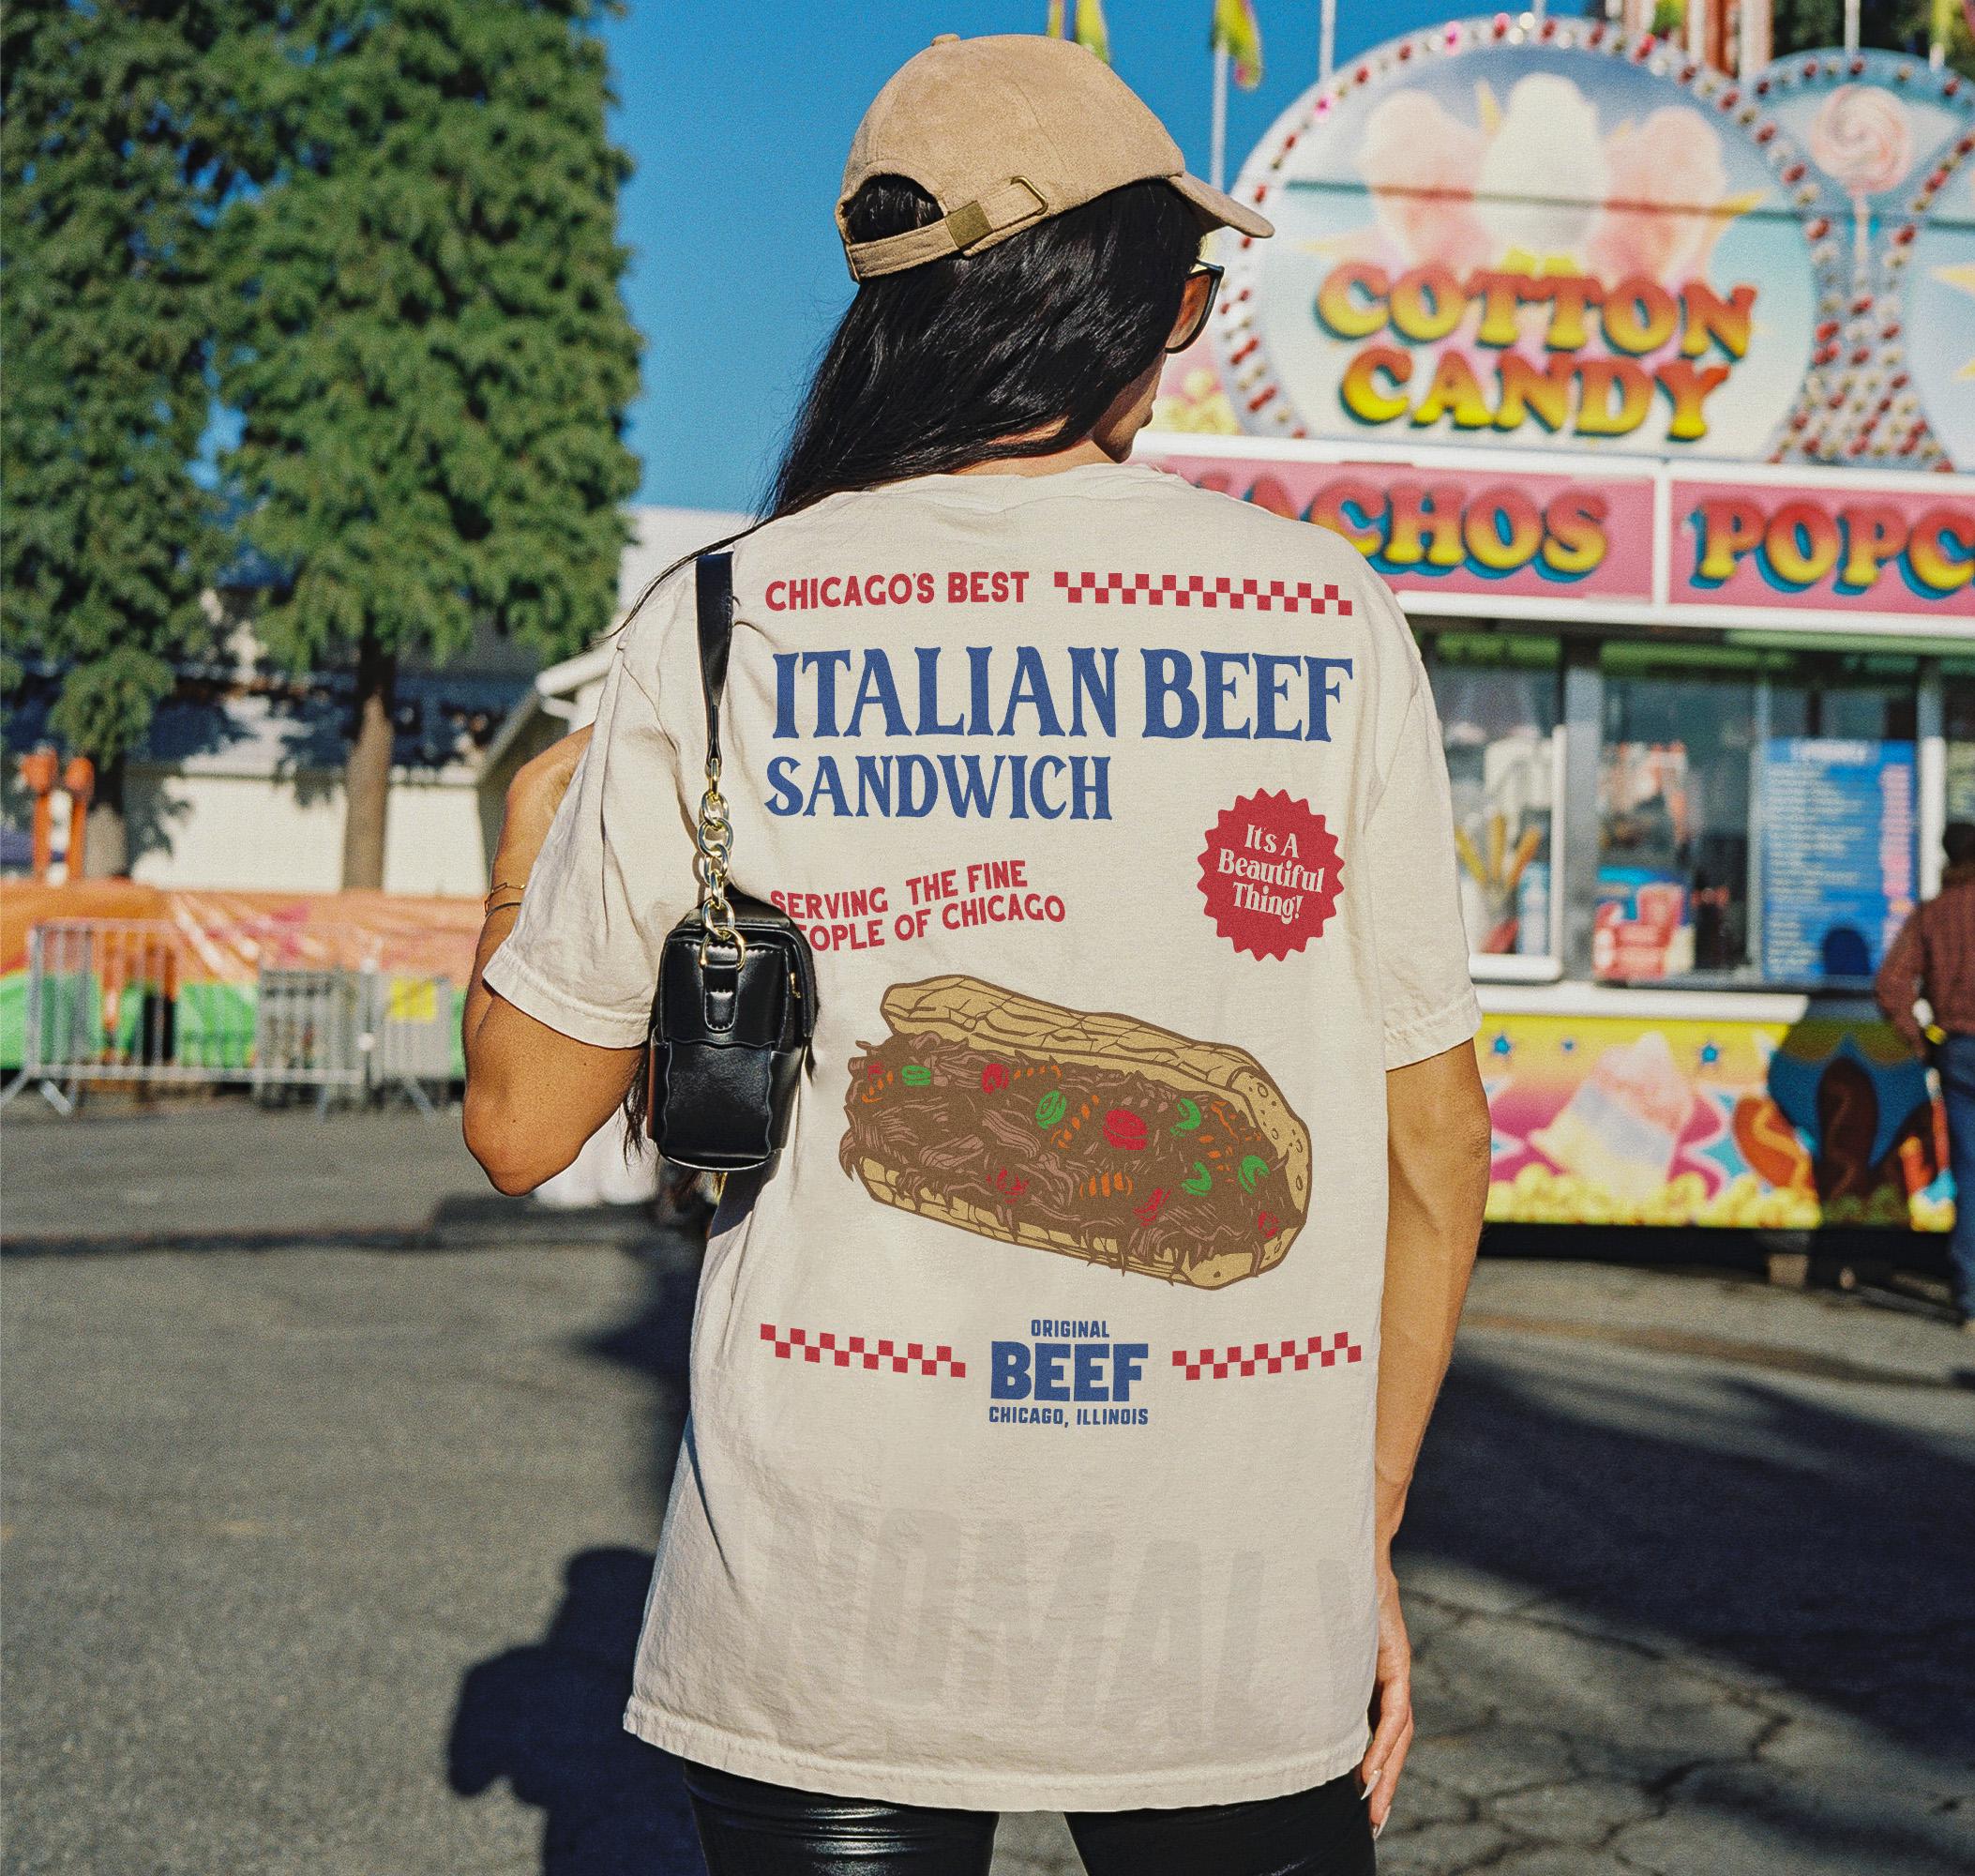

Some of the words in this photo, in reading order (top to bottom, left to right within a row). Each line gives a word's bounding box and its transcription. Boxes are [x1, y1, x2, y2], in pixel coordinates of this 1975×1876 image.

[1315, 261, 1757, 363] COTTON
[1340, 346, 1730, 441] CANDY
[1196, 472, 1609, 582] CHOS
[765, 573, 934, 611] CHICAGO'S
[948, 571, 1030, 603] BEST
[773, 646, 1119, 738] ITALIAN
[1140, 648, 1353, 741] BEEF
[765, 754, 1112, 820] SANDWICH
[1217, 847, 1325, 893] Beautiful
[1280, 833, 1300, 859] A
[770, 887, 888, 919] SERVING
[906, 870, 958, 905] THE
[967, 859, 1028, 893] FINE
[1232, 882, 1304, 925] Thing!
[797, 919, 885, 952] OPLE
[894, 909, 931, 941] OF
[942, 893, 1065, 930] CHICAGO
[1031, 1320, 1109, 1338] ORIGINAL
[990, 1341, 1148, 1402] BEEF
[988, 1407, 1070, 1429] CHICAGO,
[1077, 1408, 1149, 1426] ILLINOIS
